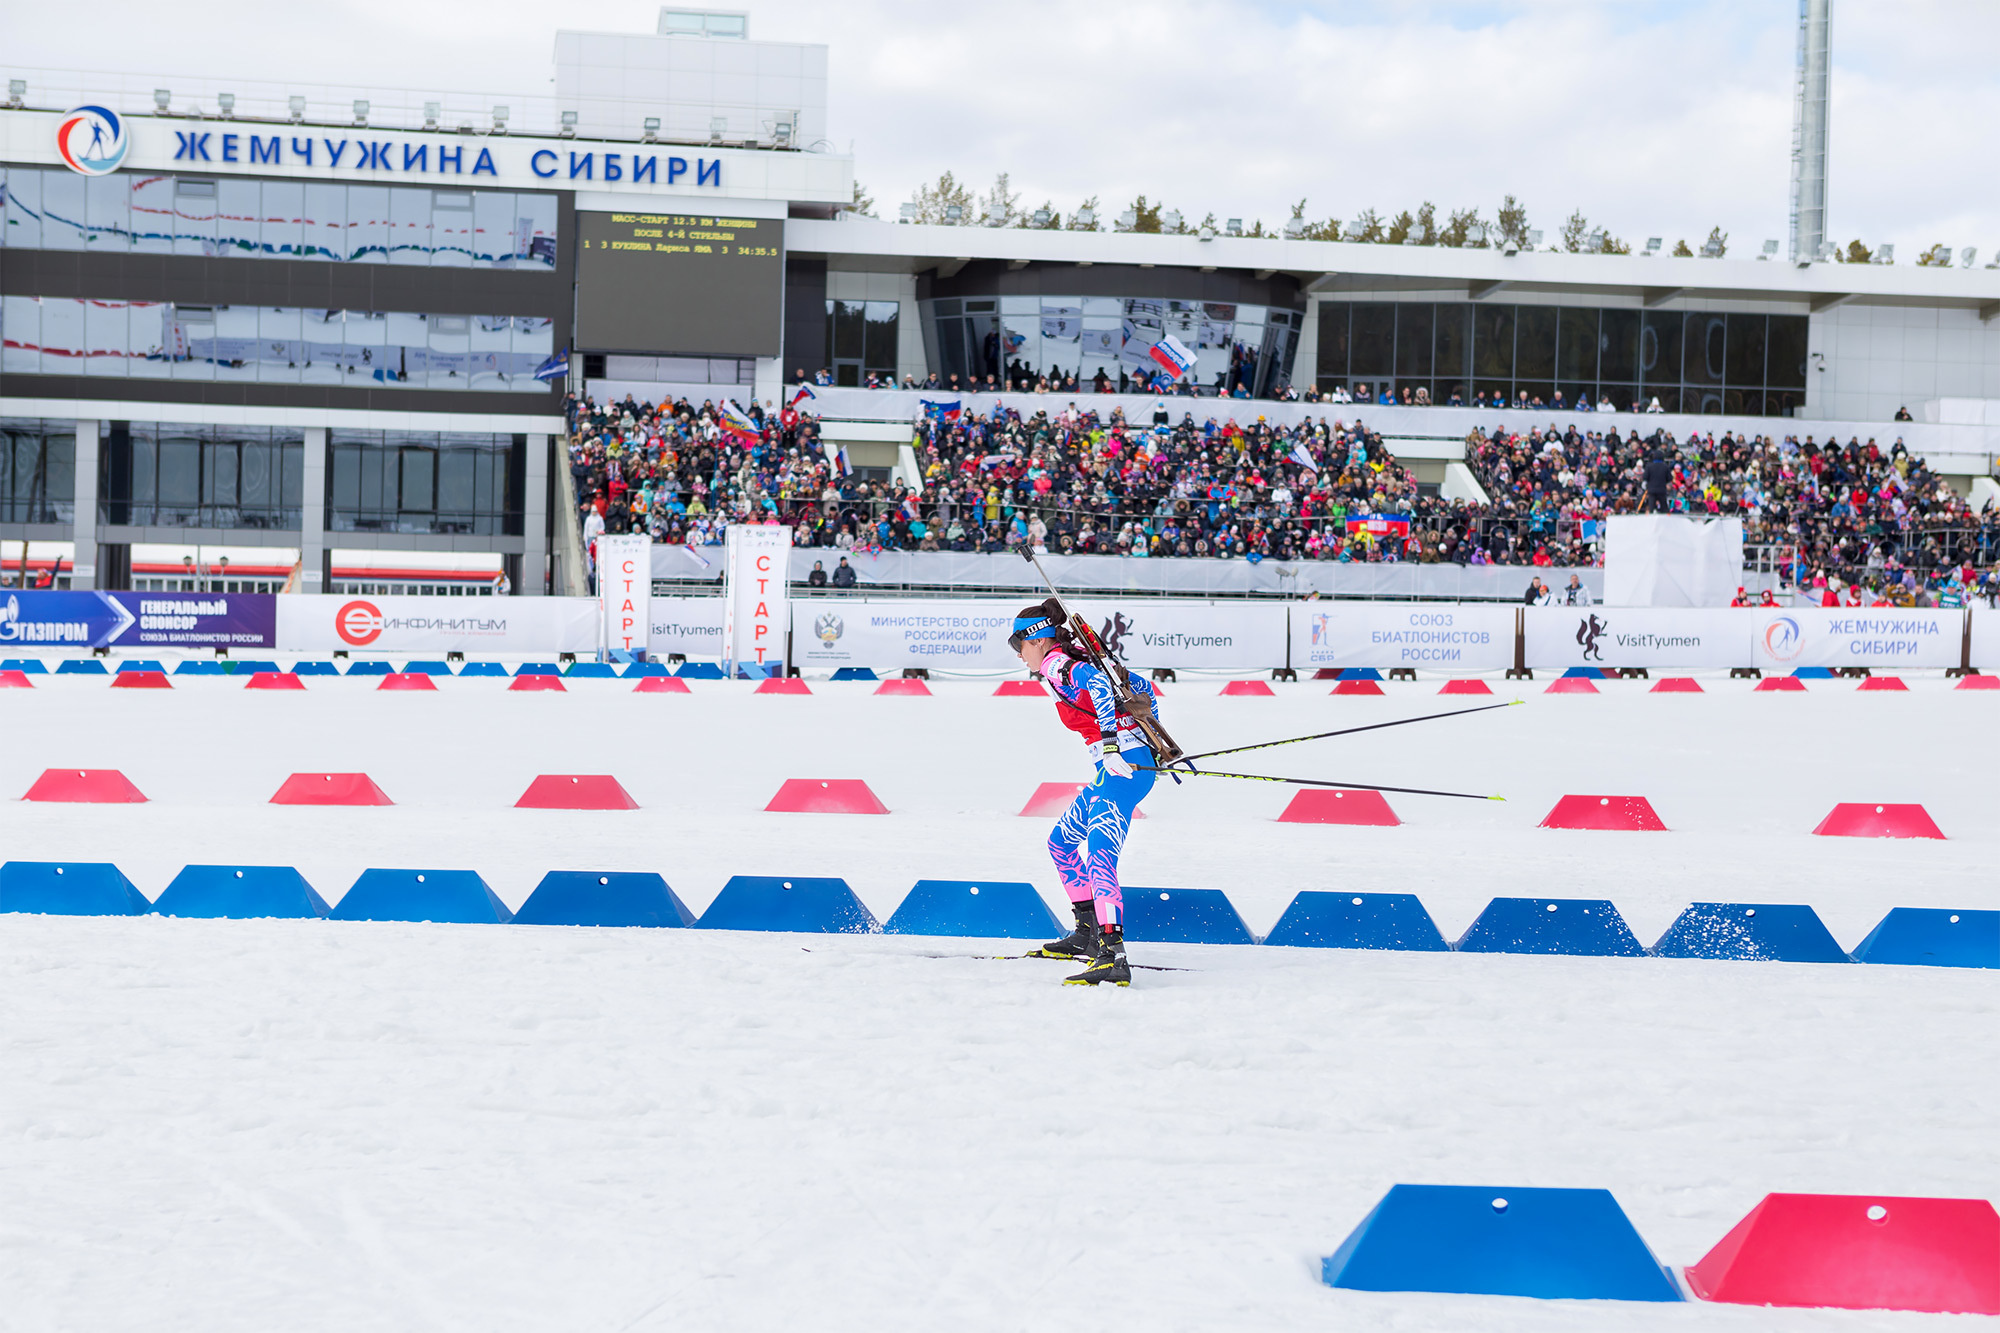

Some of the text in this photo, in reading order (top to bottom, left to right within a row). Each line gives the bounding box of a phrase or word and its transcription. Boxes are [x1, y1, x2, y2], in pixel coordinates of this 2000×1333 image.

[173, 130, 723, 188] ЖЕМЧУЖИНА СИБИРИ
[612, 214, 670, 225] МАСС-СТАРТ
[673, 217, 697, 226] 12.5
[701, 218, 713, 227] КМ
[634, 228, 664, 238] ПОСЛЕ
[584, 240, 591, 249] 1
[601, 241, 608, 249] 3
[612, 241, 652, 251] КУКЛИНА
[656, 243, 690, 254] Лариса
[722, 246, 728, 255] 3
[738, 247, 777, 257] 34:35.5
[140, 599, 228, 616] ГЕНЕРАЛЬНЫЙ
[622, 560, 634, 650] СТАРТ
[754, 555, 769, 664] СТАРТ
[140, 615, 198, 631] СПОНСОР
[384, 618, 507, 631] ИНФИНИТУМ
[871, 616, 970, 628] МИНИСТЕРСТВО
[1409, 613, 1454, 627] СОЮЗ
[1829, 620, 1940, 635] ЖЕМЧУЖИНА
[19, 622, 88, 641] ГАЗПРОМ
[140, 633, 264, 643] СОЮЗА БИАТЛОНИСТОВ РОССИИ
[651, 623, 723, 639] isitTyumen
[904, 629, 987, 641] РОССИЙСКОЙ
[1371, 631, 1490, 645] БИАТЛОНИСТОВ
[1142, 633, 1233, 650] VisitTyumen
[1616, 633, 1701, 650] VisitTyumen
[1850, 640, 1918, 655] СИБИРИ
[908, 643, 982, 656] ФЕДЕРАЦИИ
[1401, 648, 1461, 661] РОССИИ
